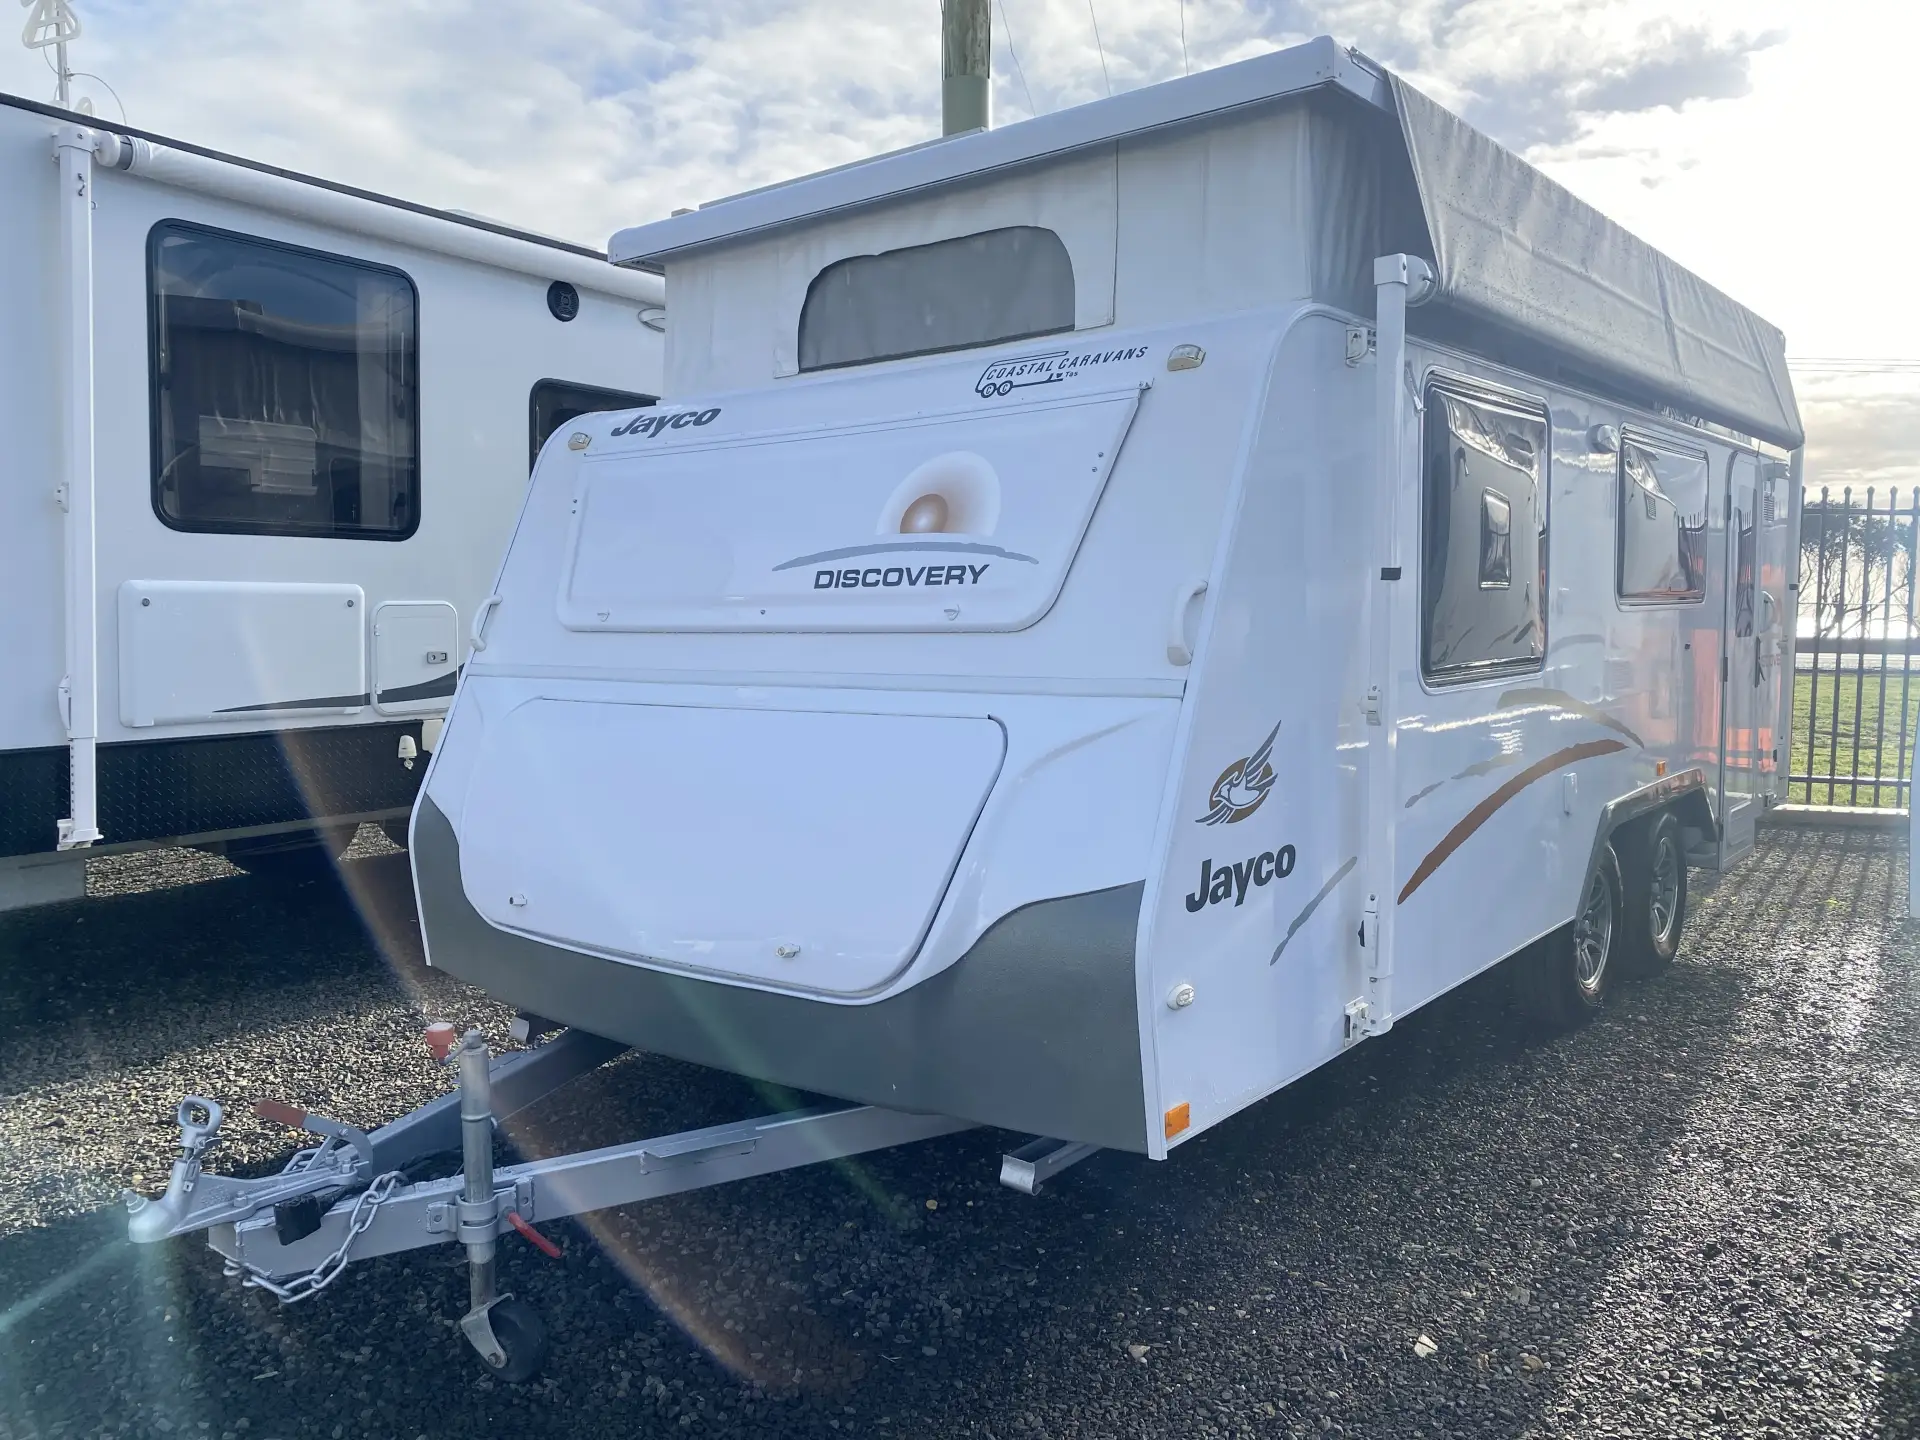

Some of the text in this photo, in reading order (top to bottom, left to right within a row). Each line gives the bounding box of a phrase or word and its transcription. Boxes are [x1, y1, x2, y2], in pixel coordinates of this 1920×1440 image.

[986, 346, 1149, 381] COASTAL CARAVANS
[610, 407, 722, 438] Jayco
[813, 563, 990, 590] DISCOVERY
[1185, 843, 1297, 913] Jayco
